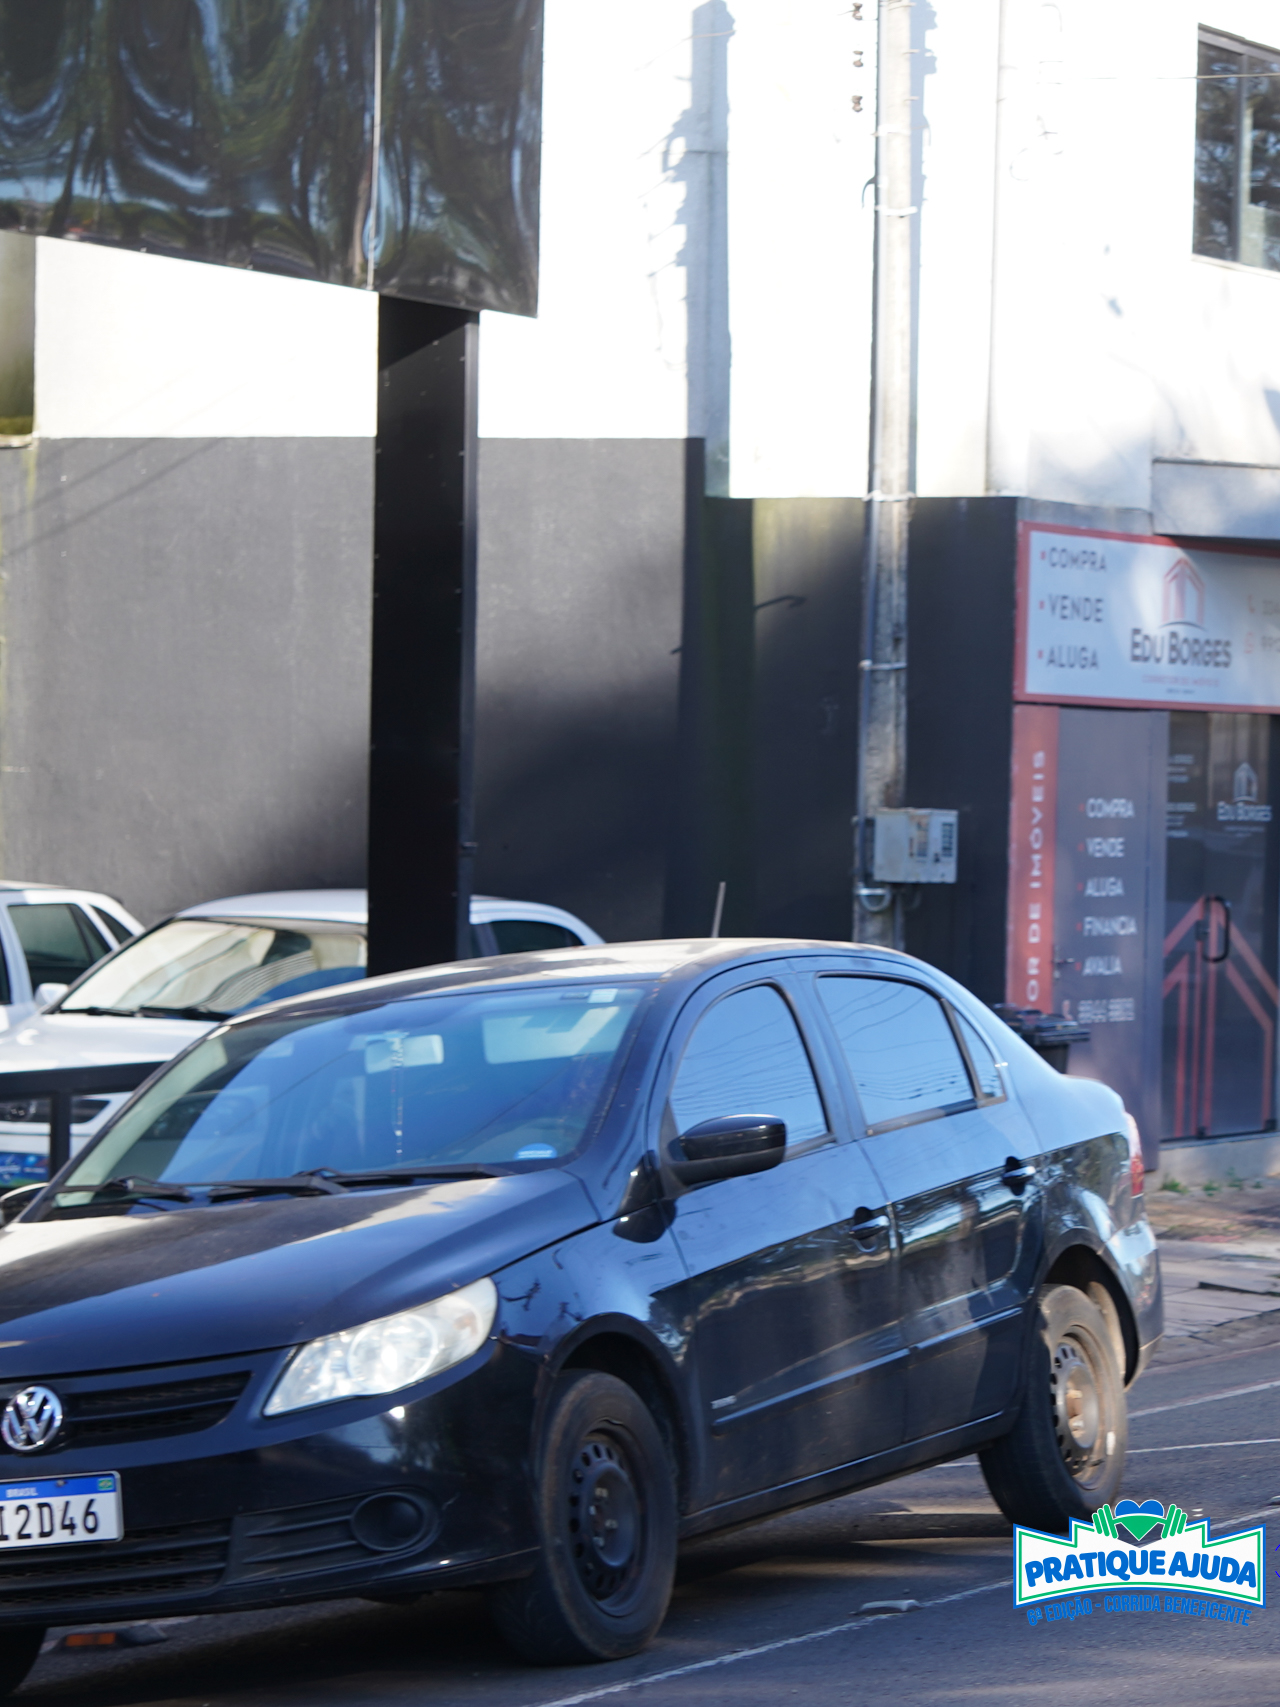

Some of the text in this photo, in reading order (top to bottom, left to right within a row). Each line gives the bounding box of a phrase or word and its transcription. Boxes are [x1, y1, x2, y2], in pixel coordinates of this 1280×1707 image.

[1048, 547, 1107, 571] COMPRA
[1047, 594, 1104, 623] VENDE
[1046, 645, 1099, 669] ALUGA
[1086, 798, 1135, 818] COMPRA
[1085, 837, 1125, 858] VENDE
[1084, 877, 1125, 897] ALUGA
